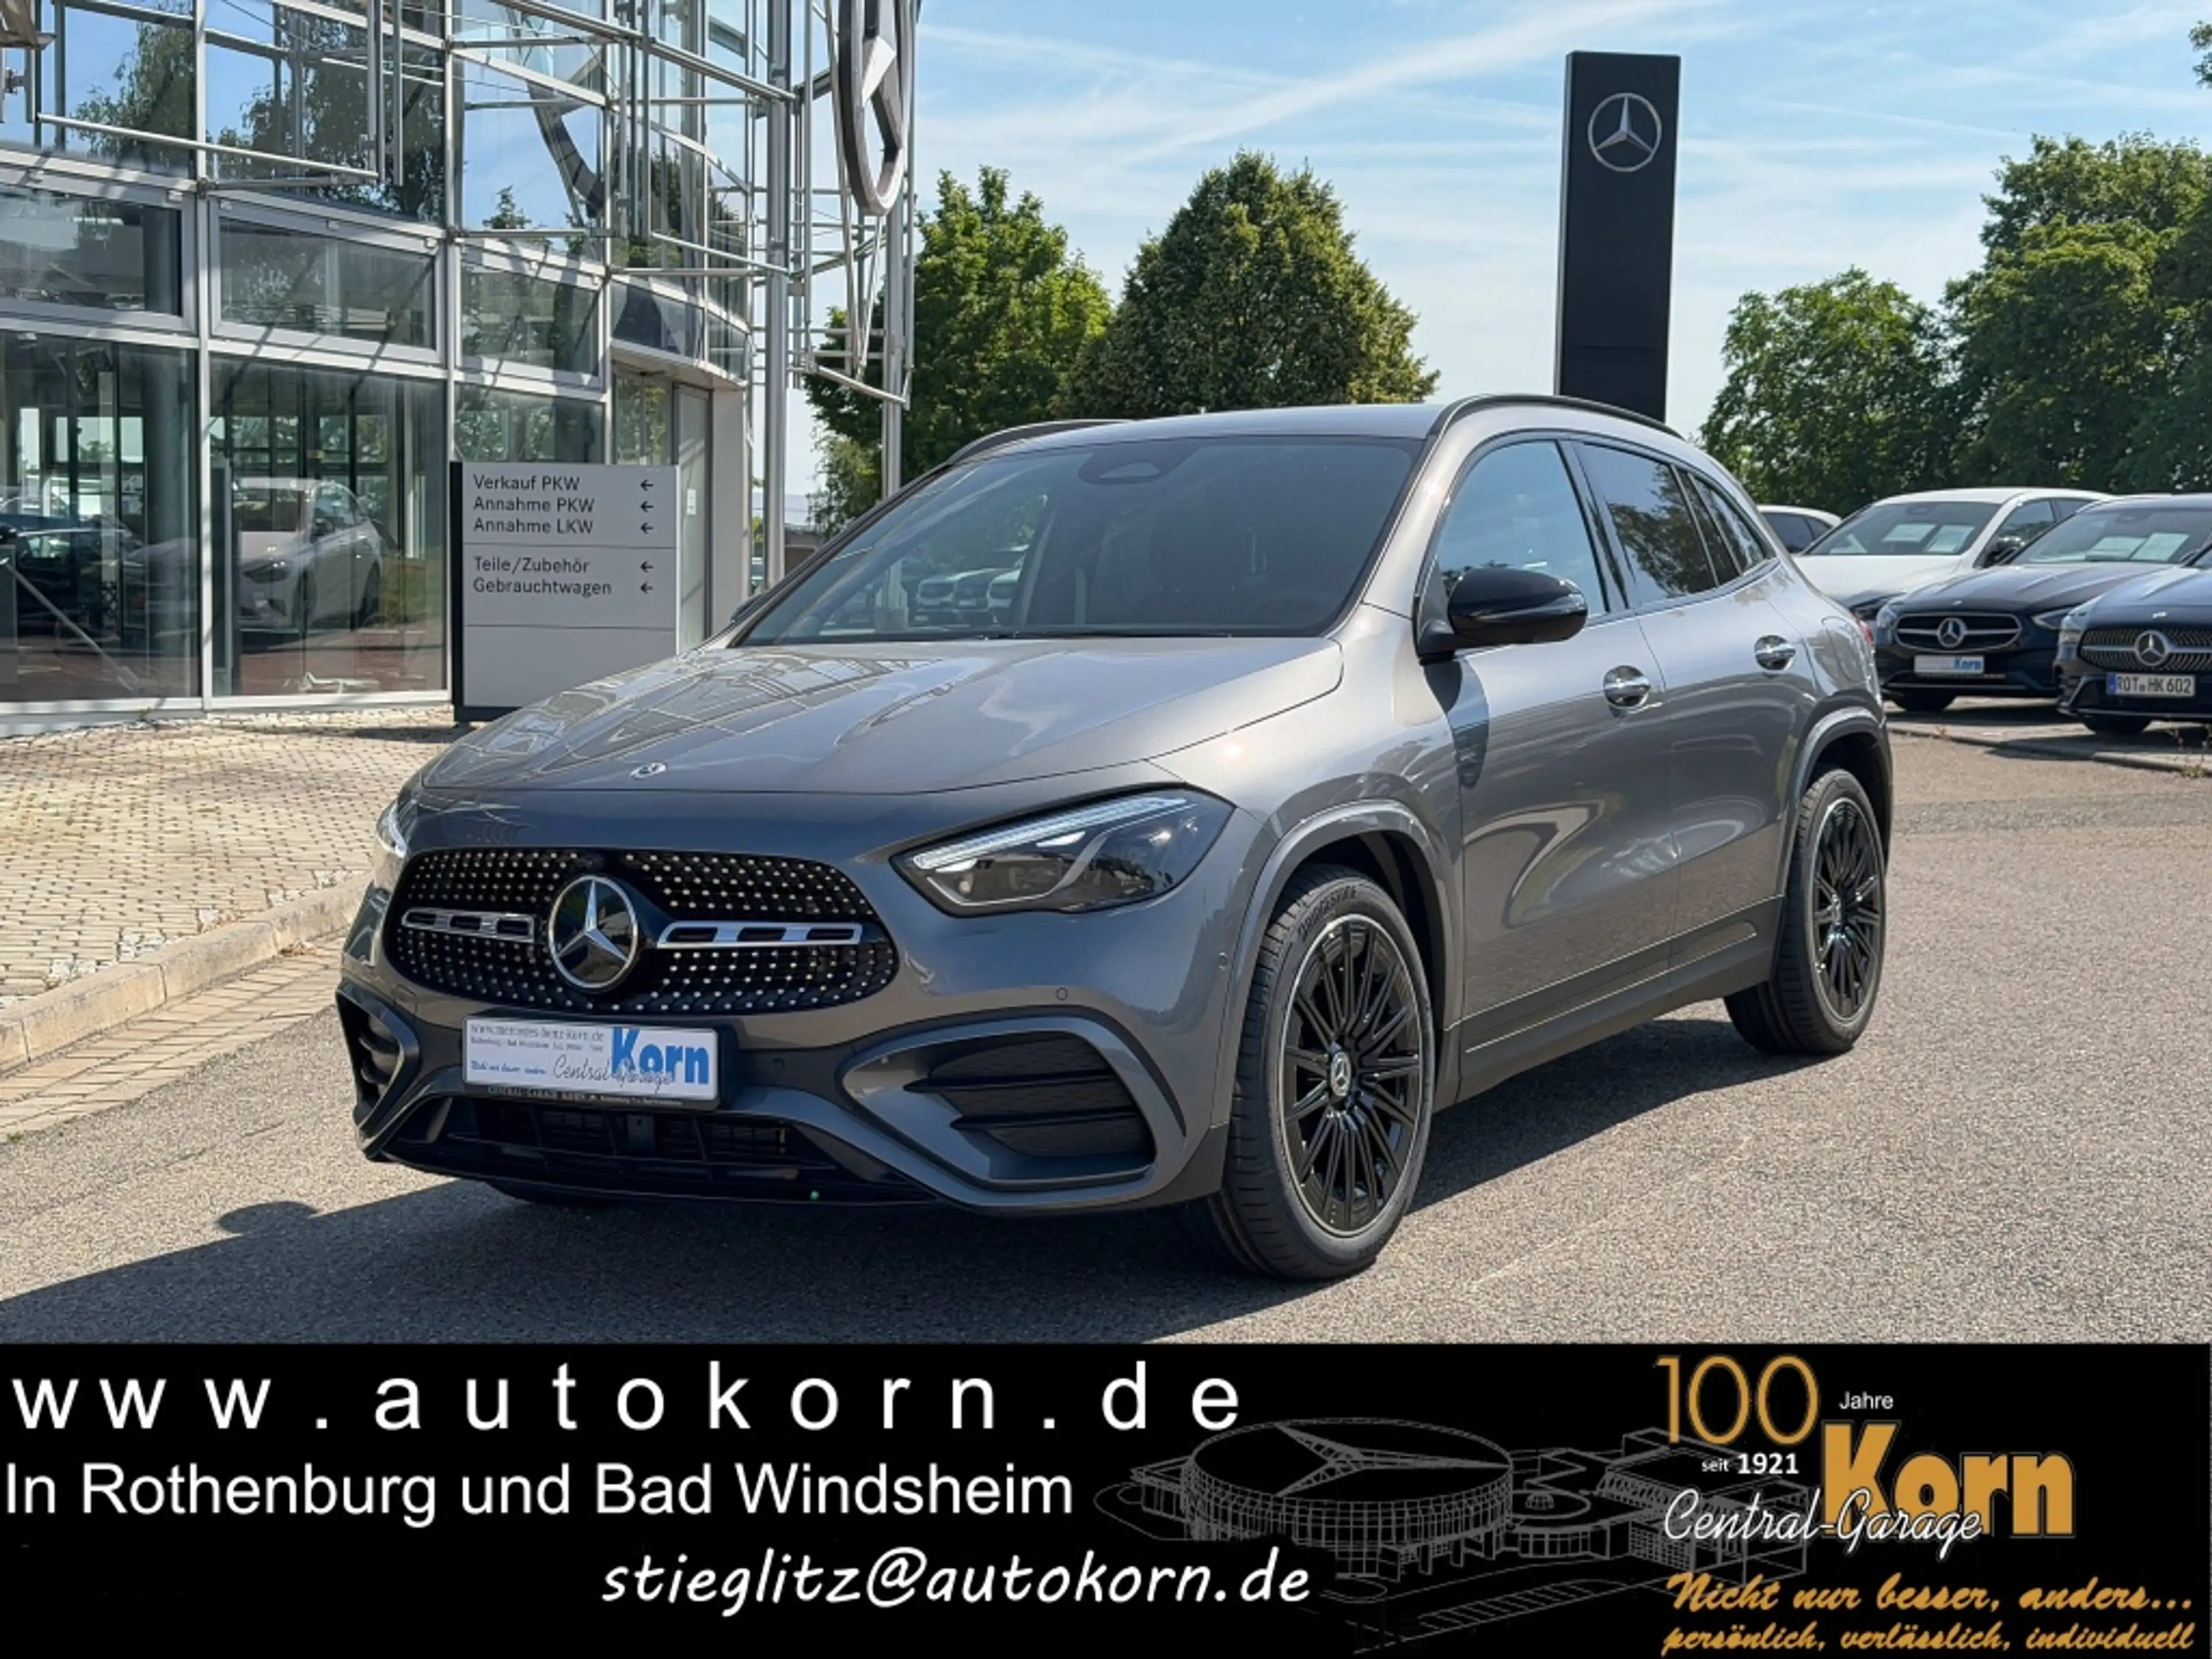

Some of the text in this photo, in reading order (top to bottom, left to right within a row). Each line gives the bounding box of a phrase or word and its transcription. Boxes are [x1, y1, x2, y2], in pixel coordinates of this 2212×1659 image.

[472, 474, 580, 491] Verkauf PKW
[473, 496, 594, 513] Annahme PKW
[473, 517, 594, 534] Annahme LKW
[474, 556, 590, 575] Teile/Zubehör
[473, 577, 612, 599] Gebrauchtwagen
[611, 1027, 710, 1085] Korn
